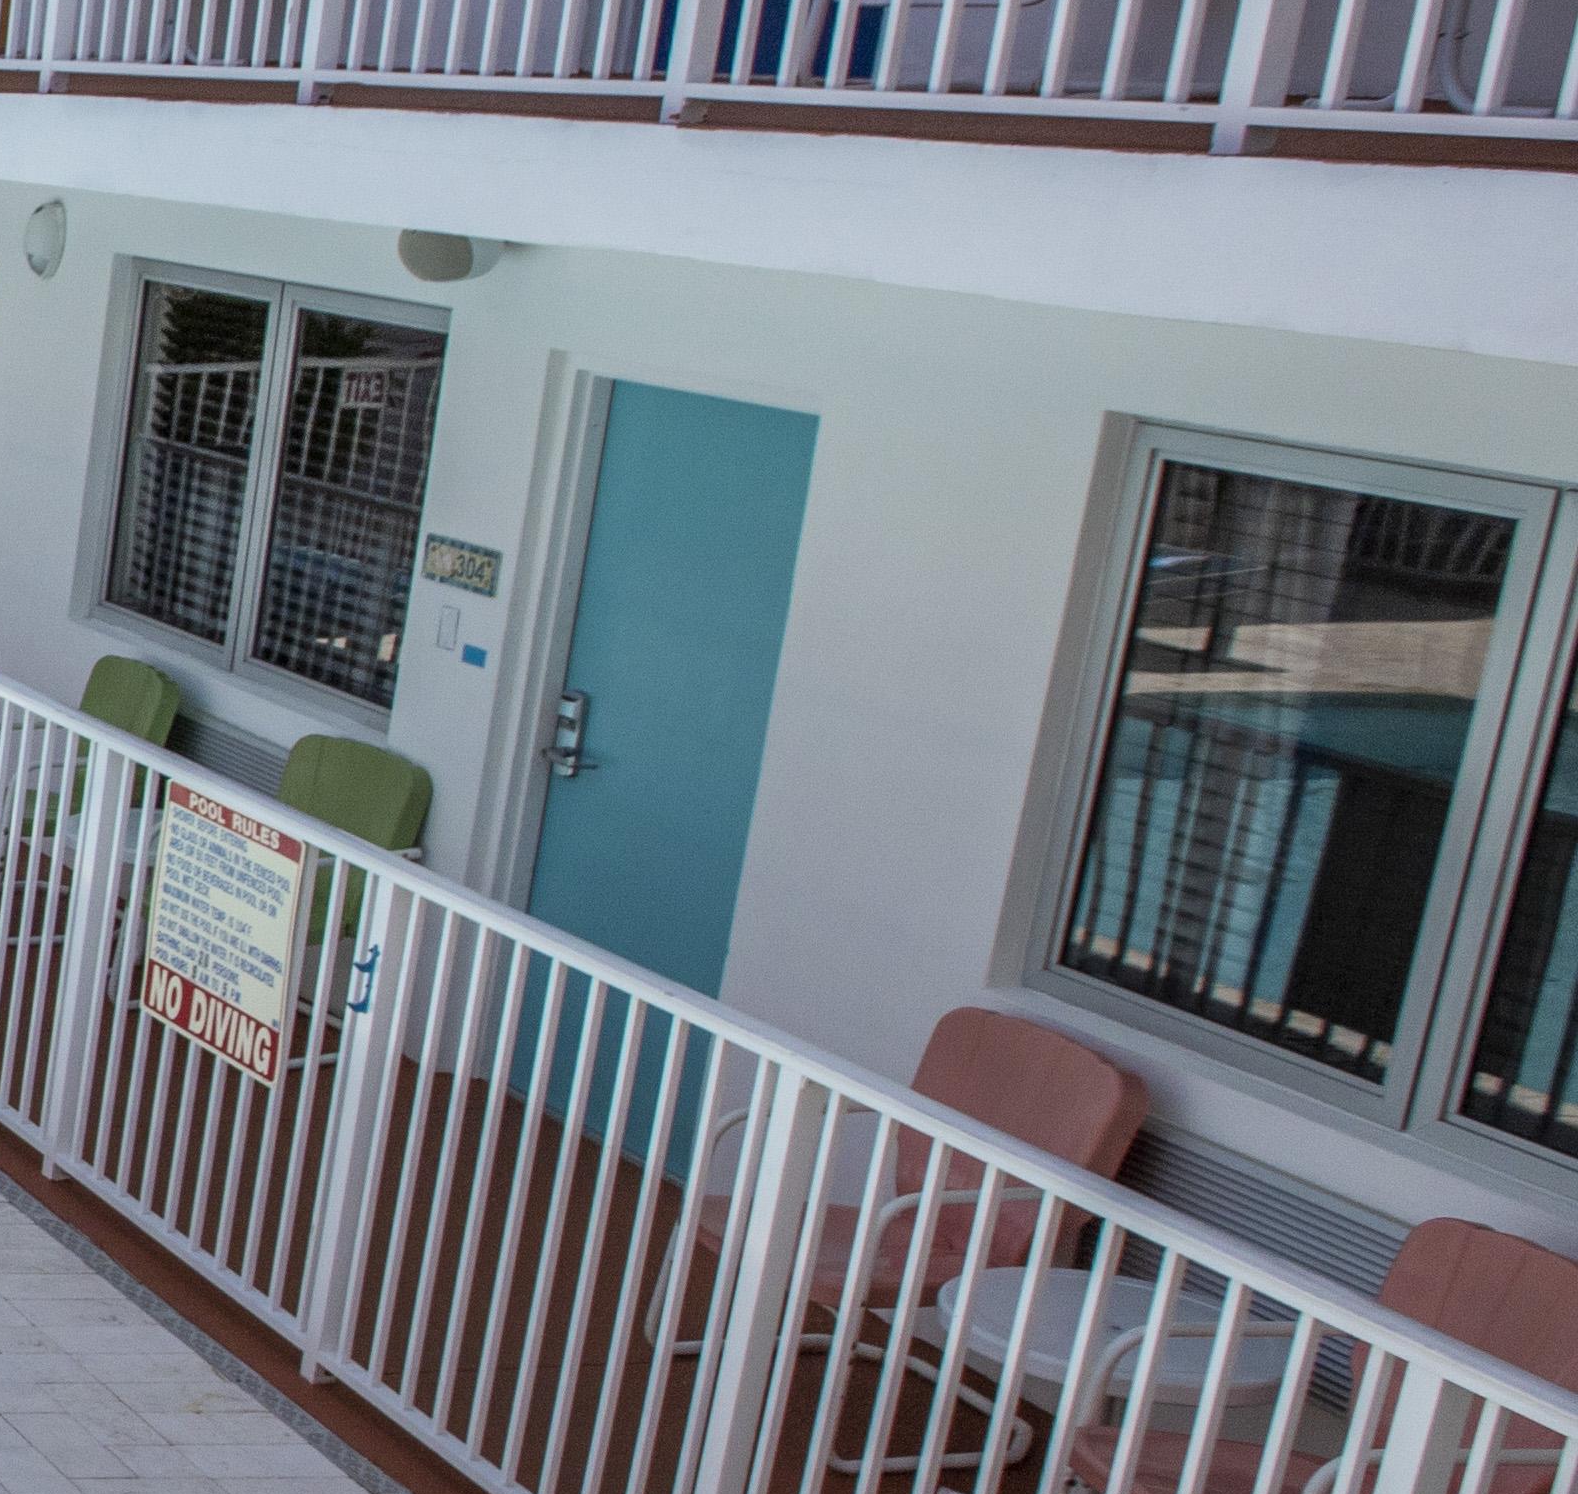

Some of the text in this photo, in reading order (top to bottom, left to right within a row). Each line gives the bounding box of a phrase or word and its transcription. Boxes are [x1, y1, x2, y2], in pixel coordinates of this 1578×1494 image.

[456, 554, 486, 583] 304
[189, 793, 280, 850] POOL RULES
[149, 964, 272, 1075] NO DIVING
